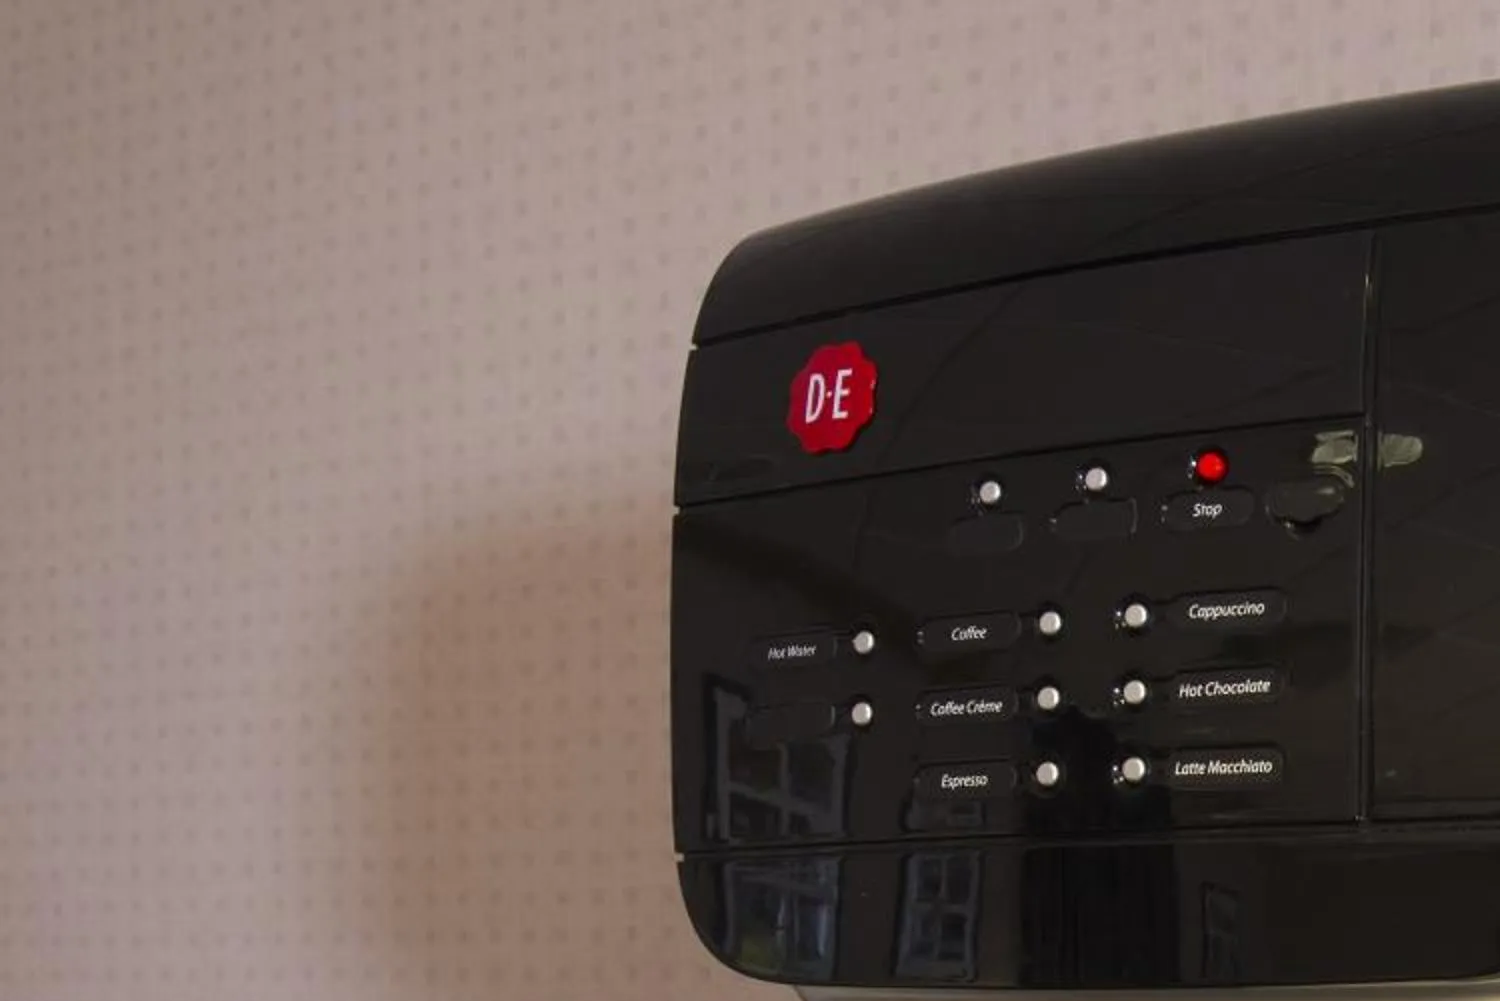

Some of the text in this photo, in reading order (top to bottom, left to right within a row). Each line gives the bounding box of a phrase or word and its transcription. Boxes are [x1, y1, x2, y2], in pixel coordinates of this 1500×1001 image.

[1191, 503, 1223, 519] Stop
[1188, 601, 1265, 621] Cappuccino
[951, 626, 988, 641] Coffee
[767, 644, 817, 660] Hot Water
[1179, 678, 1271, 698] Hot Chocolate
[930, 701, 965, 717] Coffee
[1175, 759, 1273, 775] Latte Macchiato
[941, 773, 989, 791] Espresso
